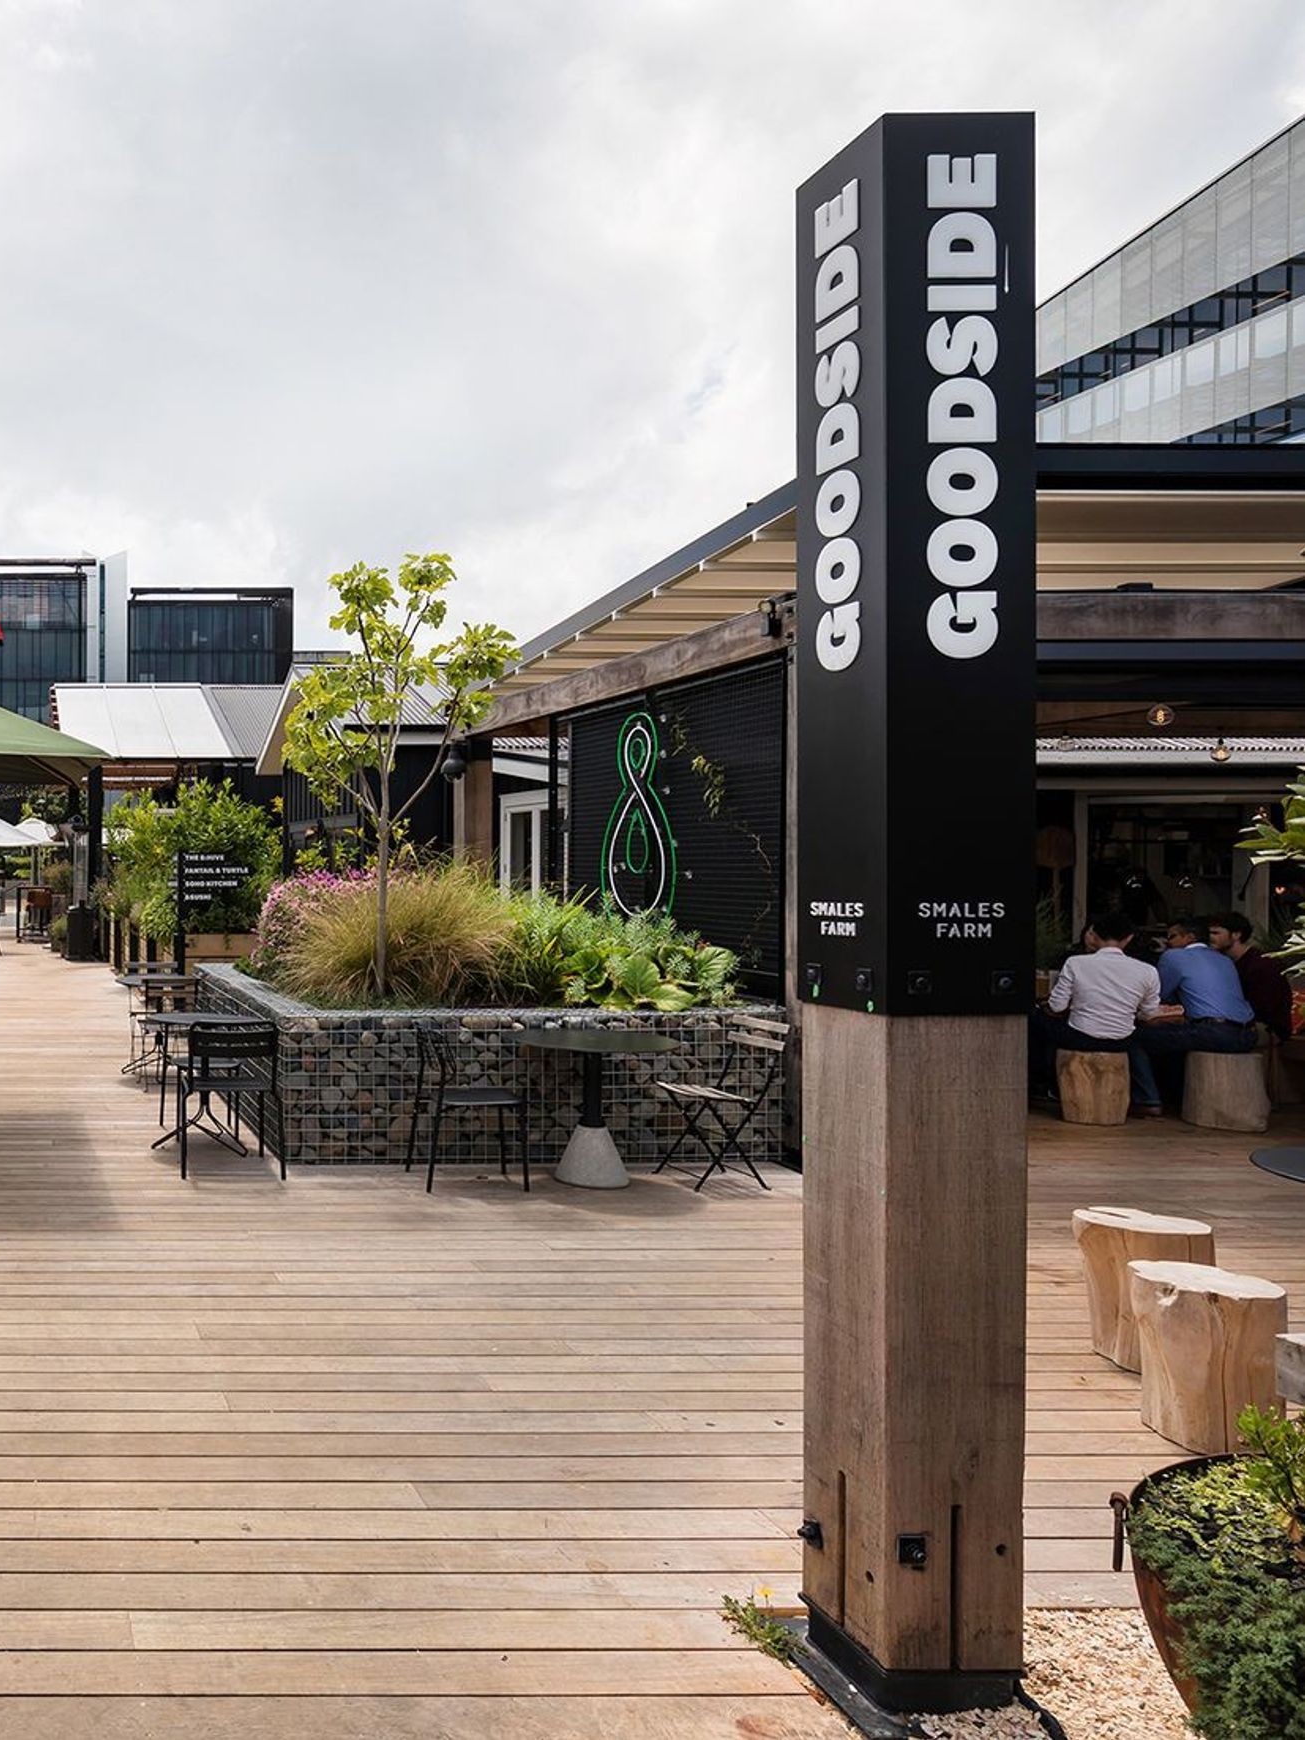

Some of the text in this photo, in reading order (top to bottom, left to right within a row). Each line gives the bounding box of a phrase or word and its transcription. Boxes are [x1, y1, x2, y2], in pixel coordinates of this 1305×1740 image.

[926, 153, 998, 660] GOODSIDE
[814, 177, 862, 672] GOODSIDE
[809, 901, 865, 918] SMALES
[917, 902, 1006, 919] SMALES
[820, 921, 857, 937] FARM
[935, 922, 993, 938] FARM
